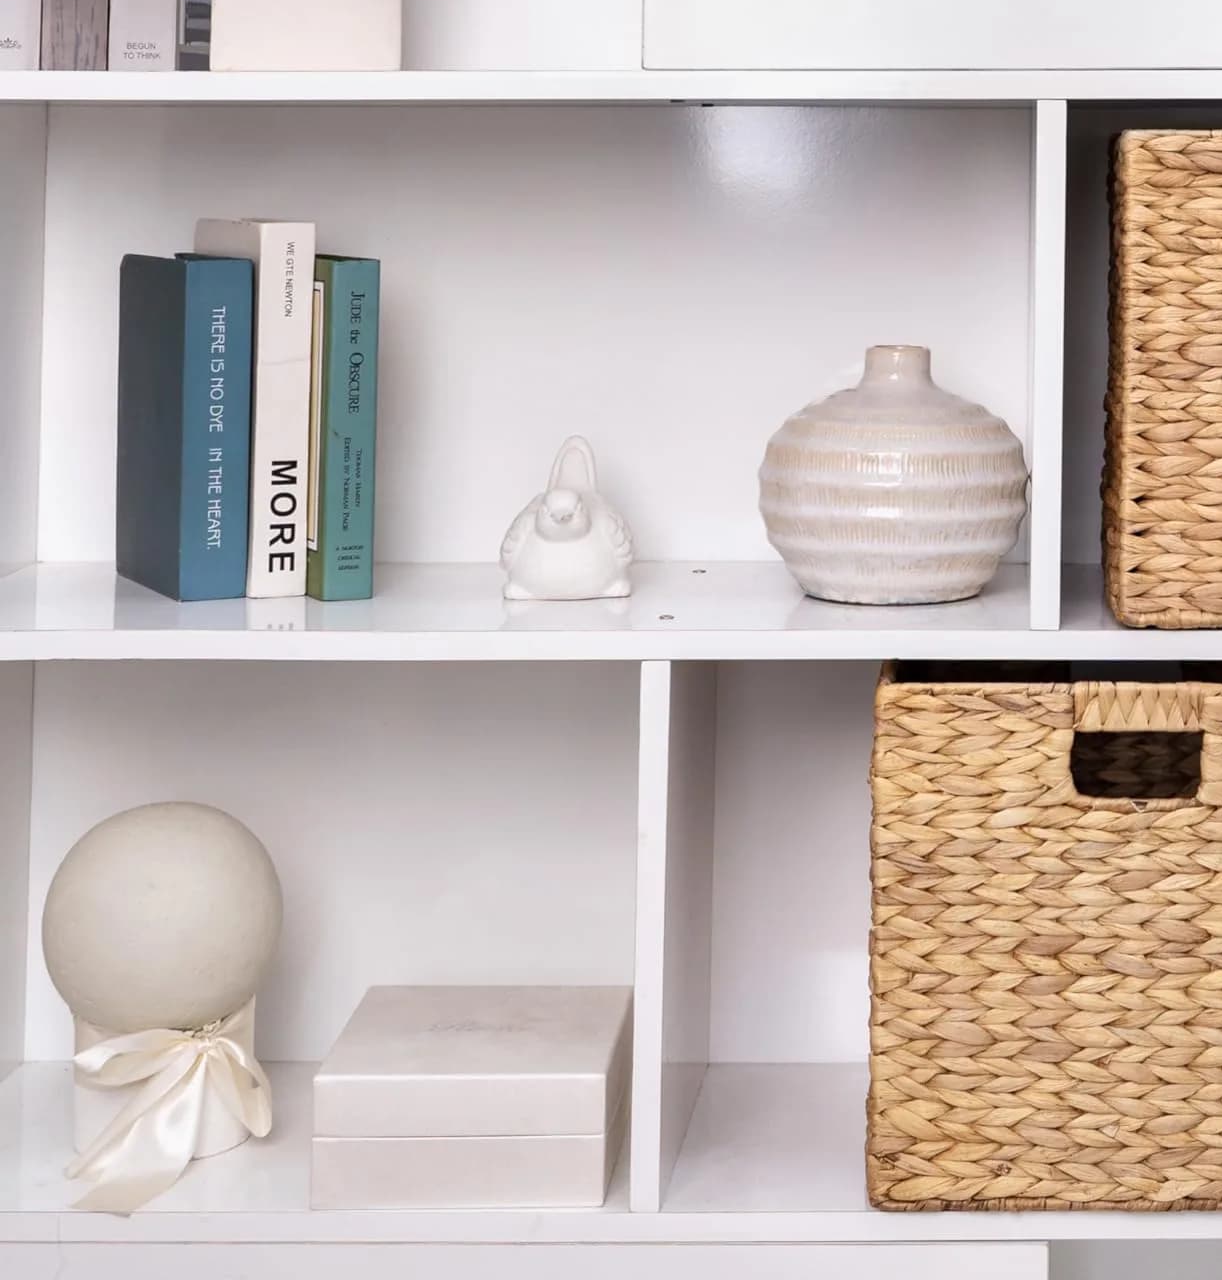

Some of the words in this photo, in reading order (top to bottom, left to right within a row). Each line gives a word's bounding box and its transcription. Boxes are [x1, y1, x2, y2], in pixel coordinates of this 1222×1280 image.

[123, 51, 135, 60] TO
[136, 51, 161, 60] THINK
[126, 42, 156, 50] BEGUN
[286, 241, 296, 256] WE
[285, 258, 295, 277] GTE
[284, 278, 294, 318] NEWTON
[350, 290, 366, 324] JUDE
[210, 305, 226, 354] THERE
[349, 329, 361, 345] the
[210, 358, 225, 373] IS
[209, 377, 225, 401] NO
[348, 352, 365, 414] OBSCURE
[208, 405, 225, 433] DYE
[208, 447, 223, 462] IN
[207, 466, 223, 495] THE
[207, 499, 222, 550] HEART.
[268, 459, 298, 574] MORE
